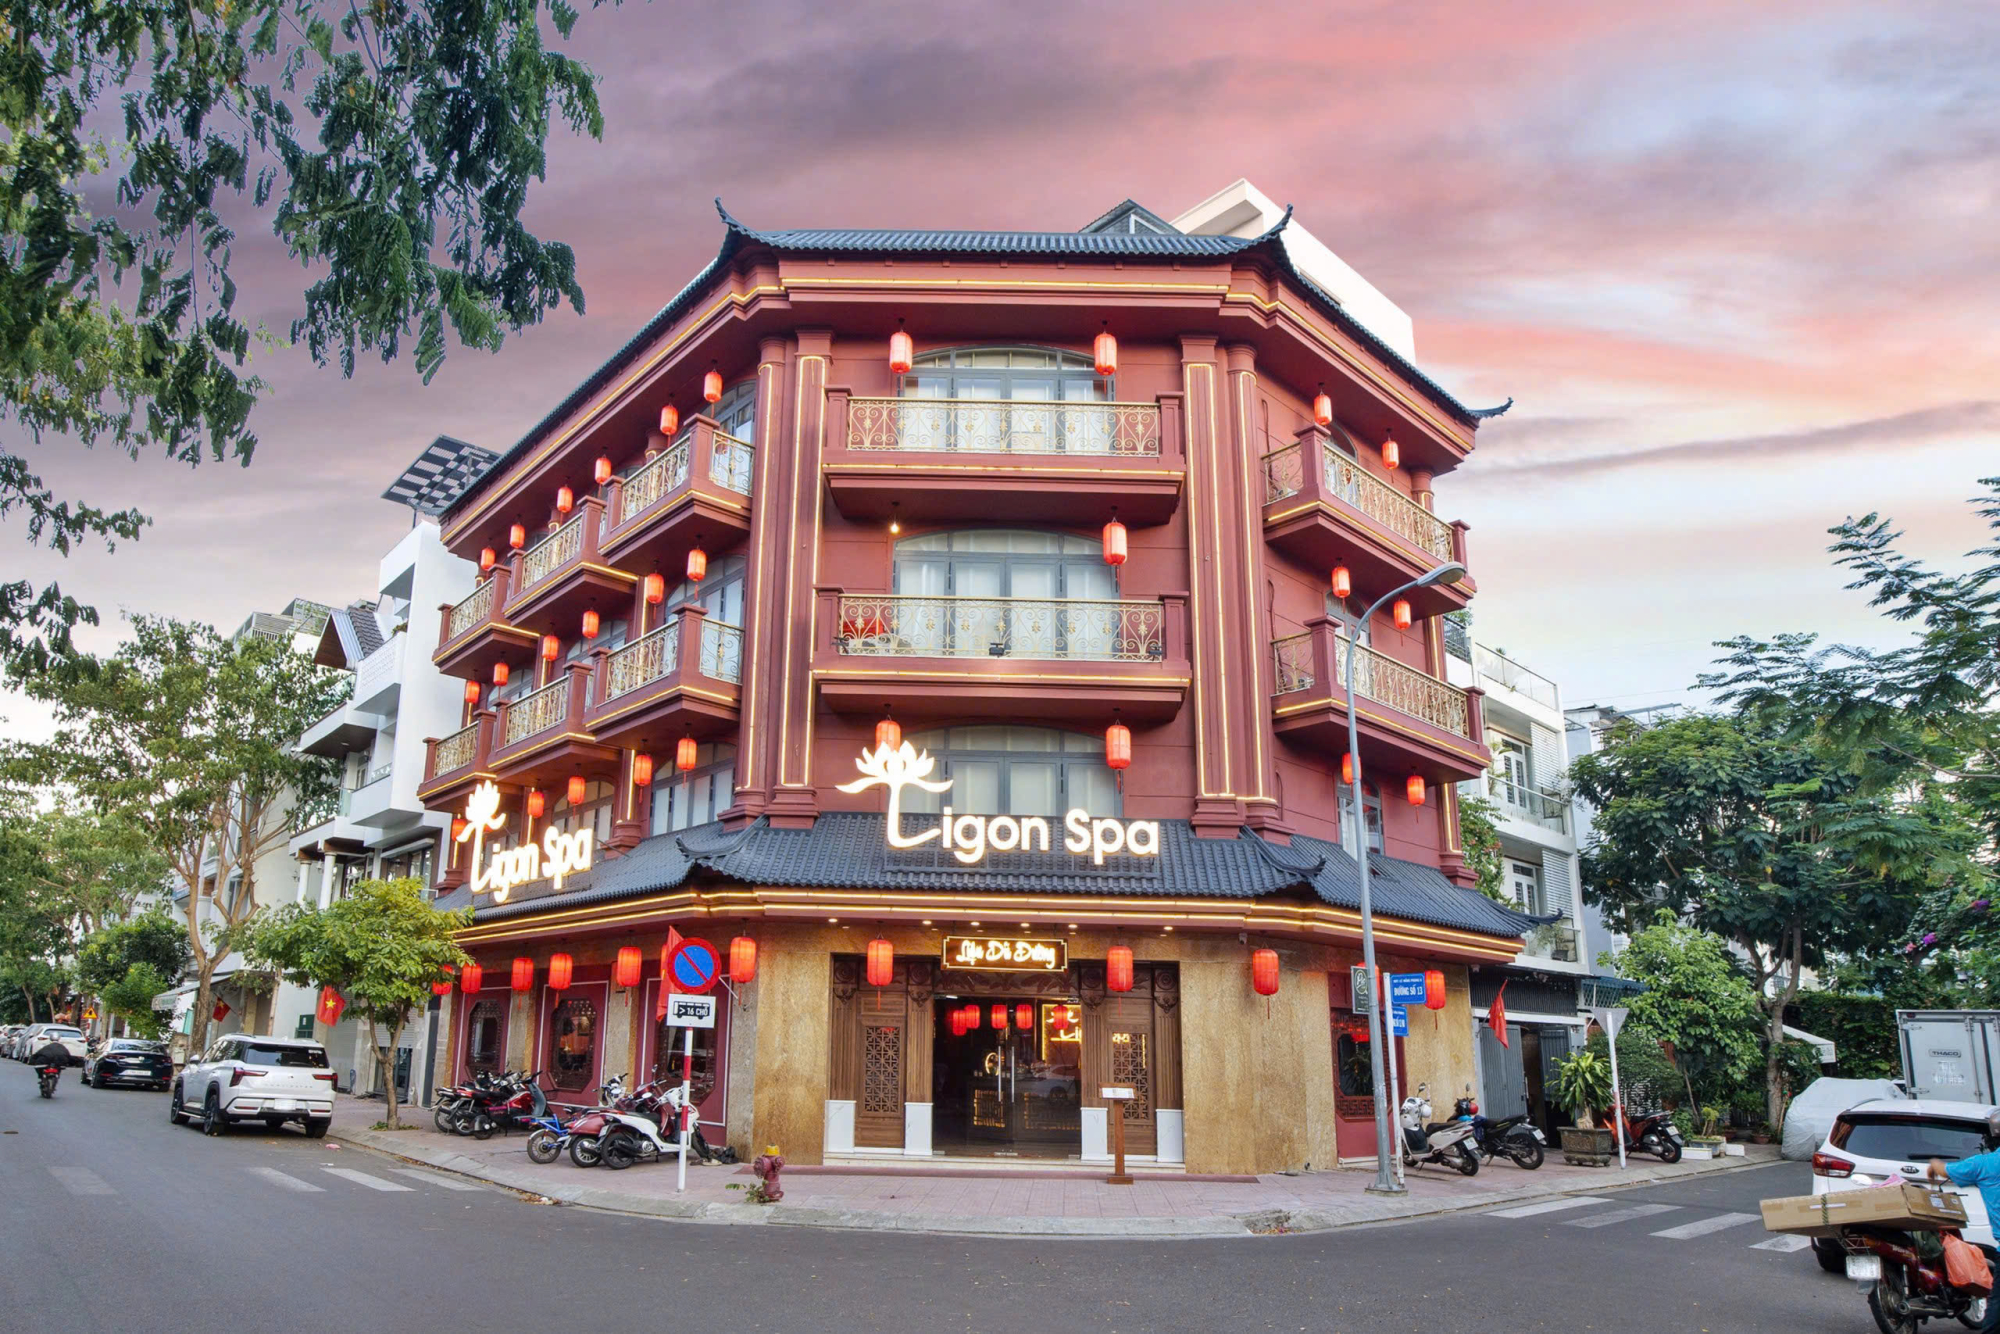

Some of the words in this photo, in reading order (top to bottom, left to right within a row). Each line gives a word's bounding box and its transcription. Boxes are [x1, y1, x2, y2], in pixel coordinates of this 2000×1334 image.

[886, 772, 1049, 864] Ligon
[1064, 808, 1159, 865] Spa
[470, 815, 540, 903] Ligon
[542, 826, 593, 889] Spa
[1417, 986, 1423, 995] 13
[687, 1007, 694, 1015] 16
[1902, 1165, 1918, 1173] KIA
